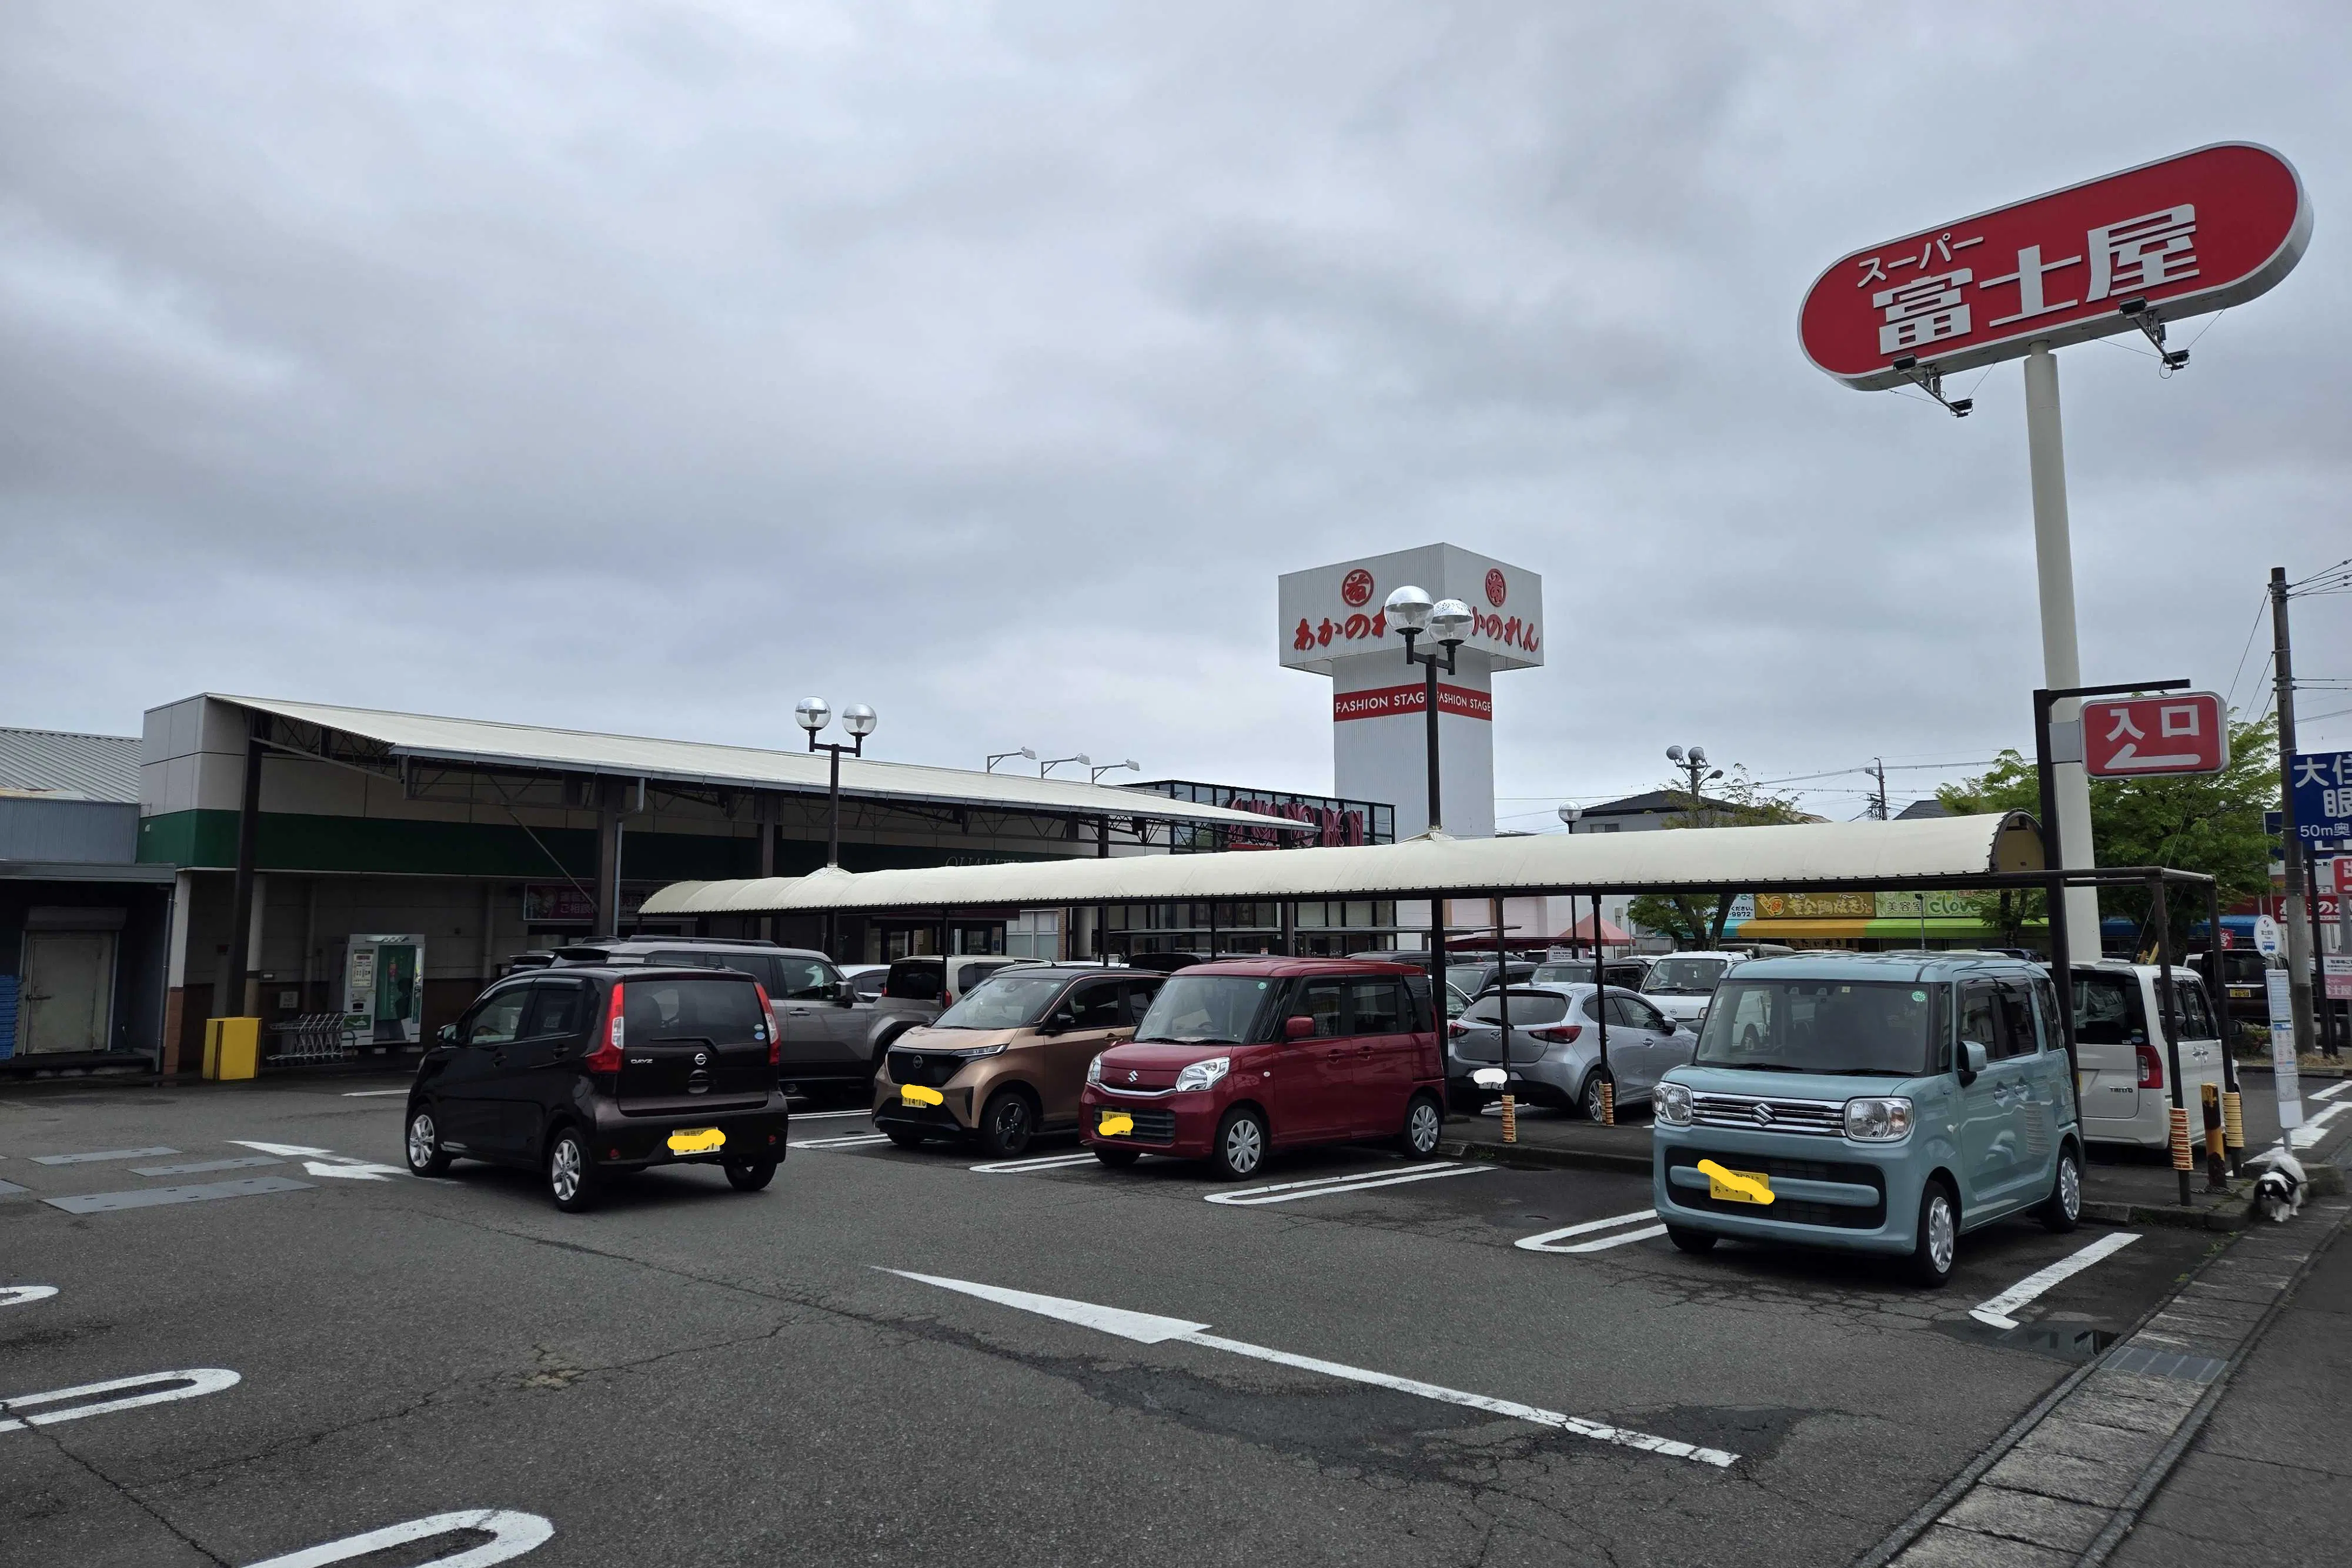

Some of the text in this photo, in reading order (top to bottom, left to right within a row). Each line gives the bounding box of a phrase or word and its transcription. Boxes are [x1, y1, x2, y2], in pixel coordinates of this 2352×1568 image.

[1857, 232, 1984, 288] スーパー
[1872, 203, 2200, 355] 富士屋
[1294, 606, 1388, 650] あかの
[1472, 606, 1539, 652] かのれん
[1335, 692, 1425, 713] FASHION STAG
[1437, 692, 1492, 712] ASHION STAGE
[2105, 704, 2200, 742] 入口
[2300, 823, 2350, 837] 50m奥
[1887, 901, 1922, 912] 美容室
